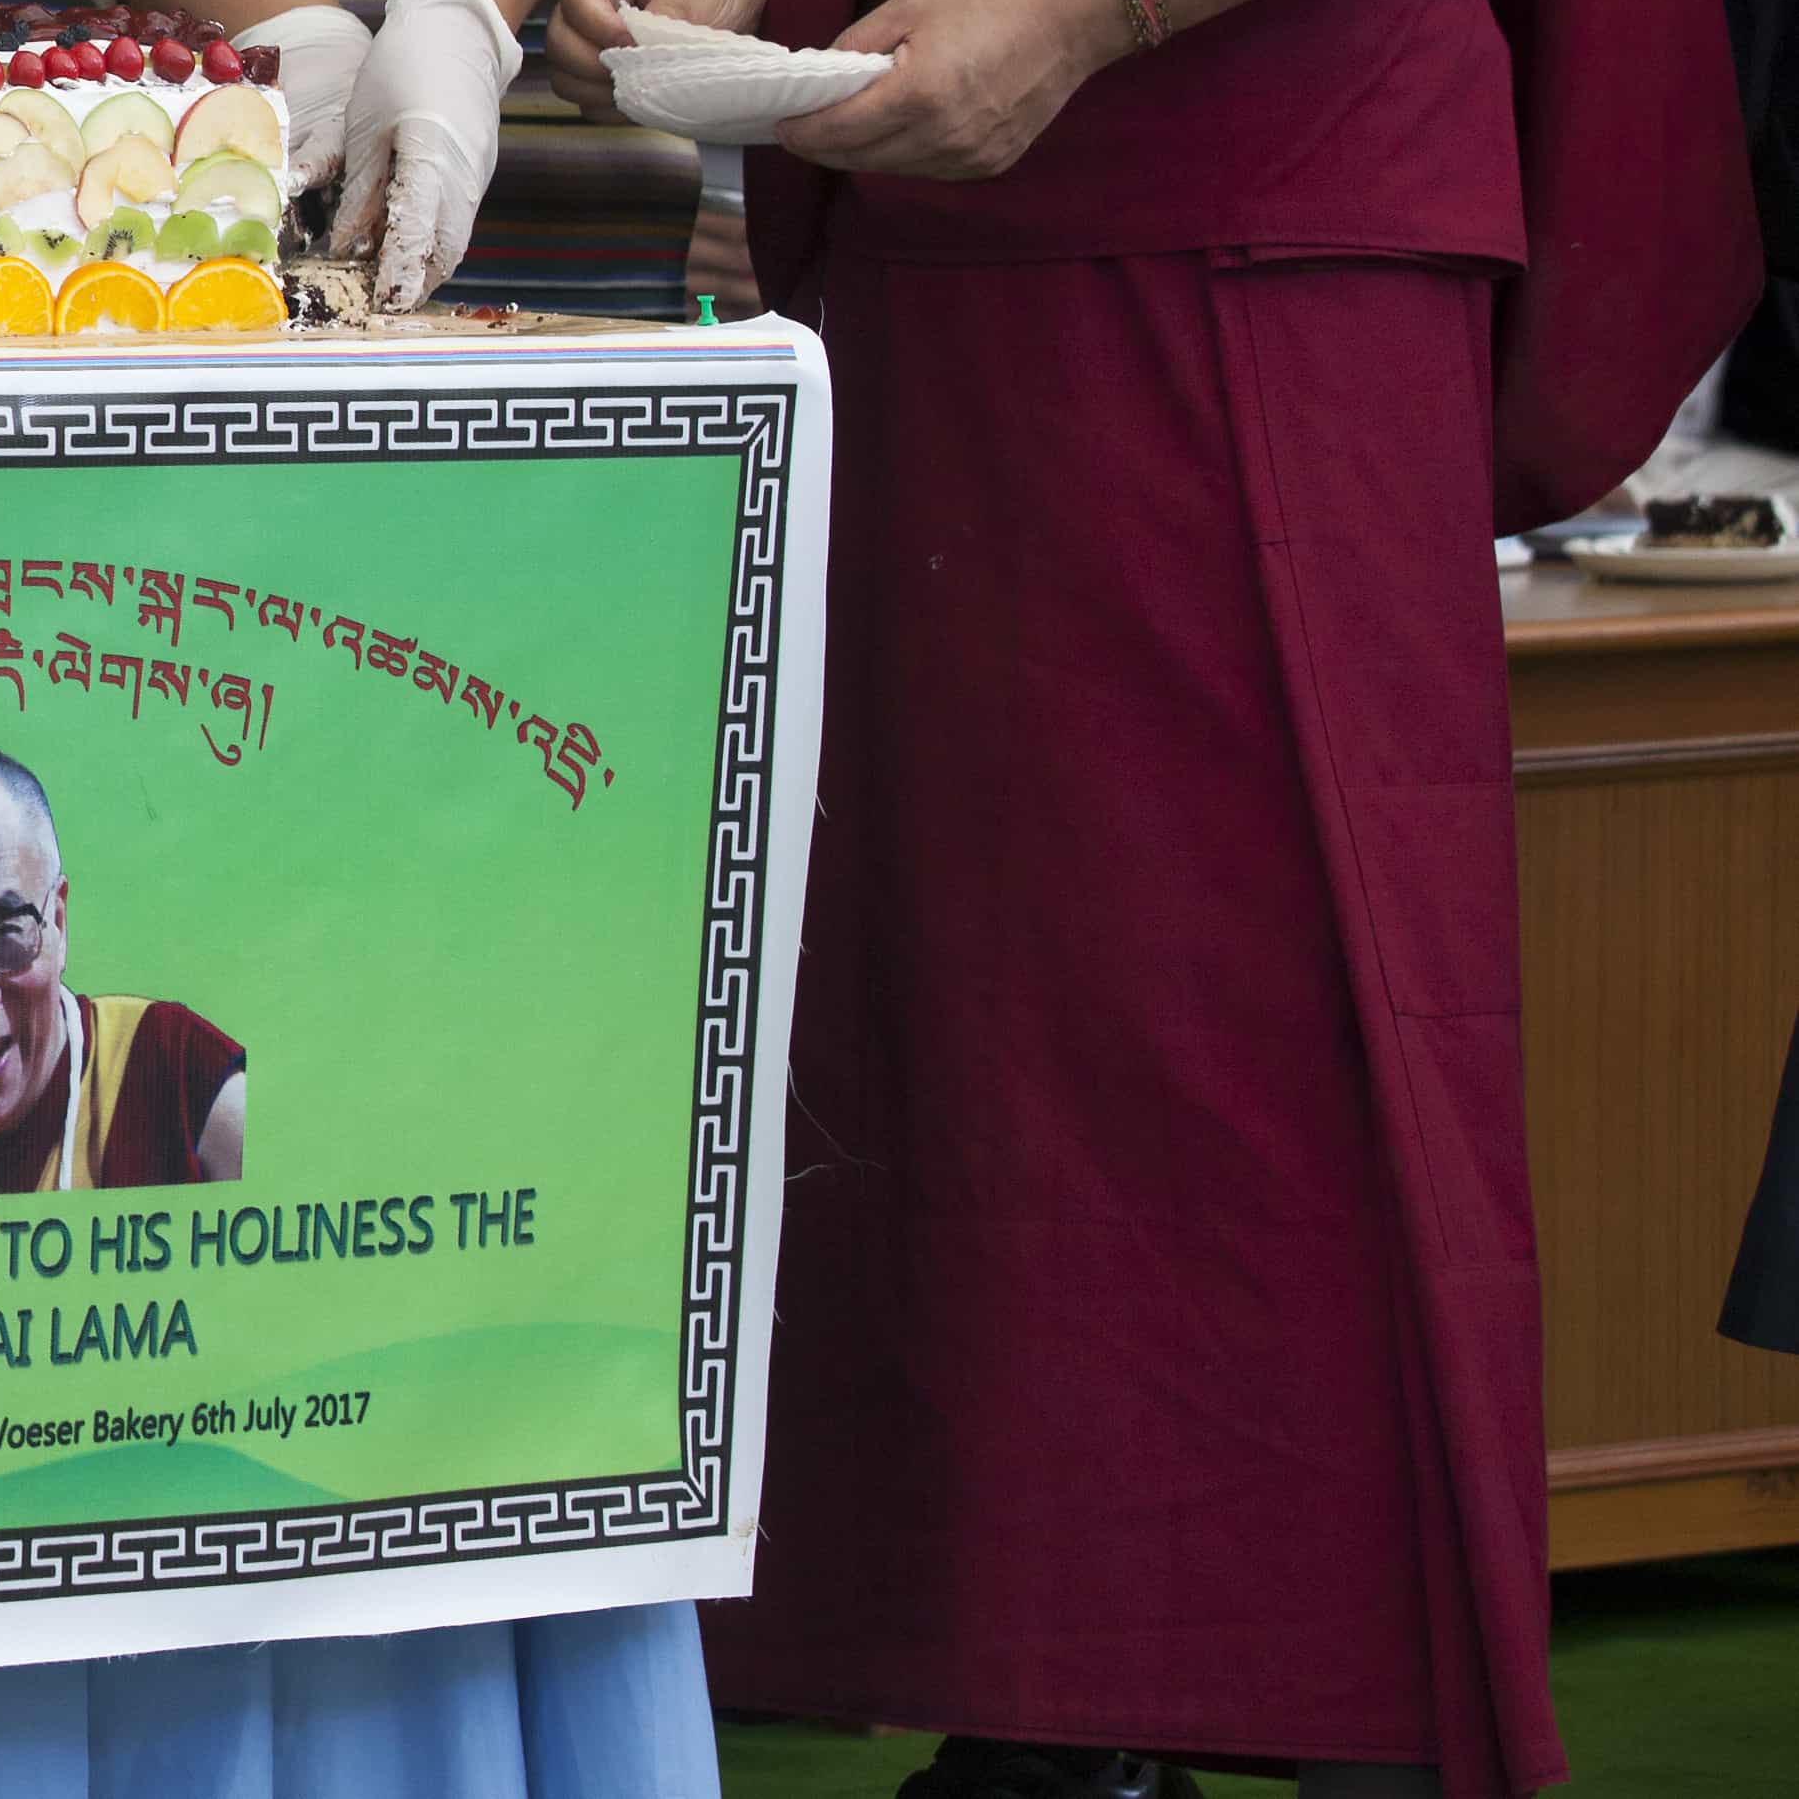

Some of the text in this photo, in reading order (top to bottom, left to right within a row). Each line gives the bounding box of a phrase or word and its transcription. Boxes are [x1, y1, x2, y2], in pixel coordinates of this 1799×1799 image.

[0, 1217, 73, 1280] TO
[90, 1211, 172, 1275] HIS
[190, 1195, 434, 1268] HOLINESS
[449, 1188, 537, 1251] THE
[50, 1299, 198, 1366] LAMA
[93, 1409, 184, 1447] Bakery
[191, 1402, 236, 1435] 6th
[243, 1395, 297, 1439] July
[305, 1391, 371, 1428] 2017
